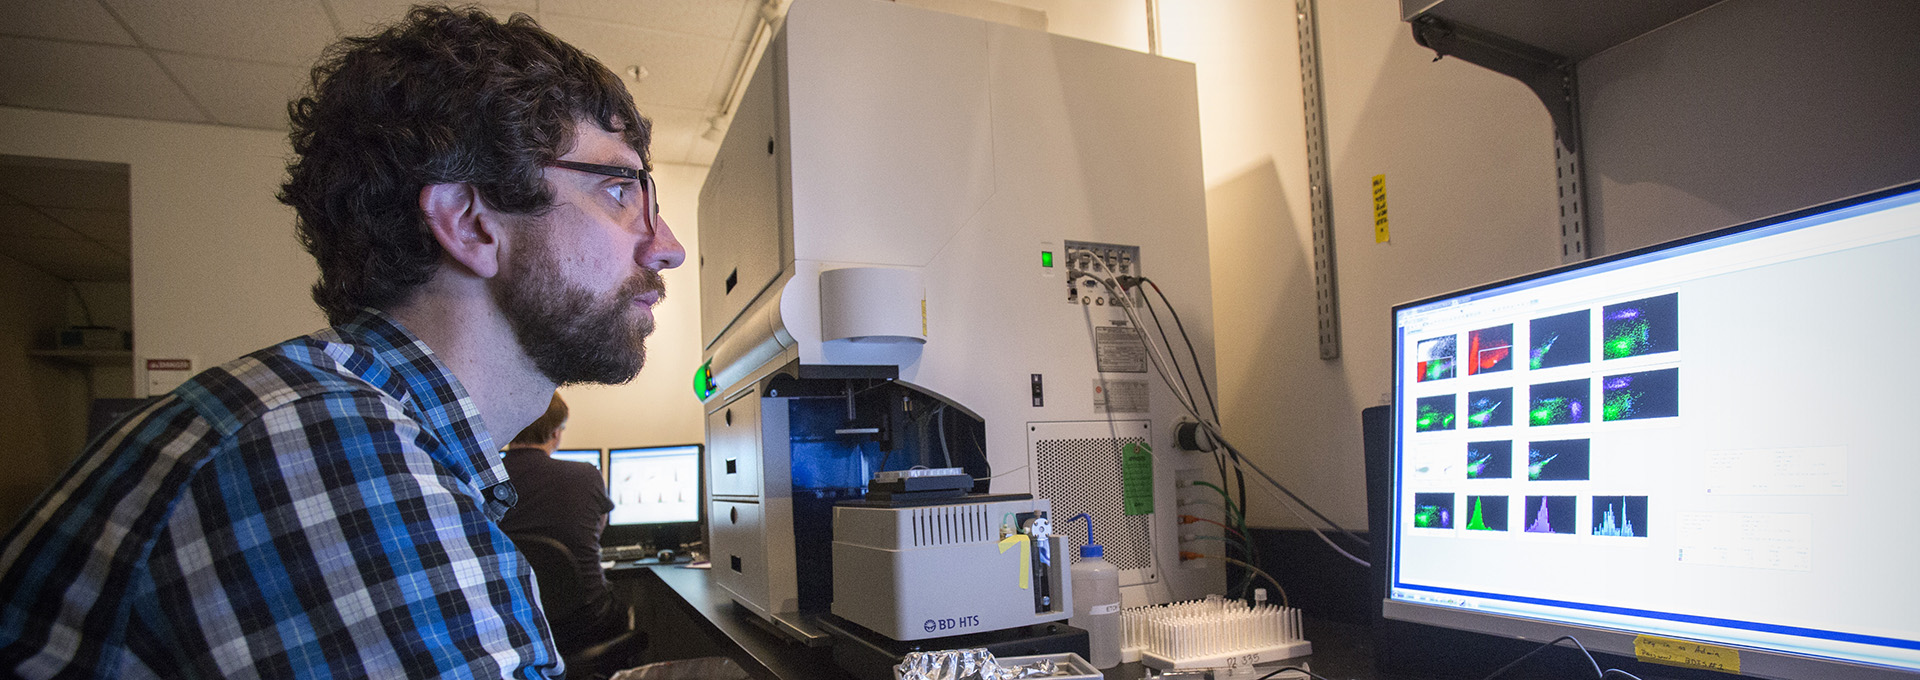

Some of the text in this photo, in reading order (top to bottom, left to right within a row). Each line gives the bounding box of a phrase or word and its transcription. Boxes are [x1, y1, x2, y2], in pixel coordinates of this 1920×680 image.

[938, 615, 980, 631] BD HTS
[1694, 645, 1720, 658] Admin
